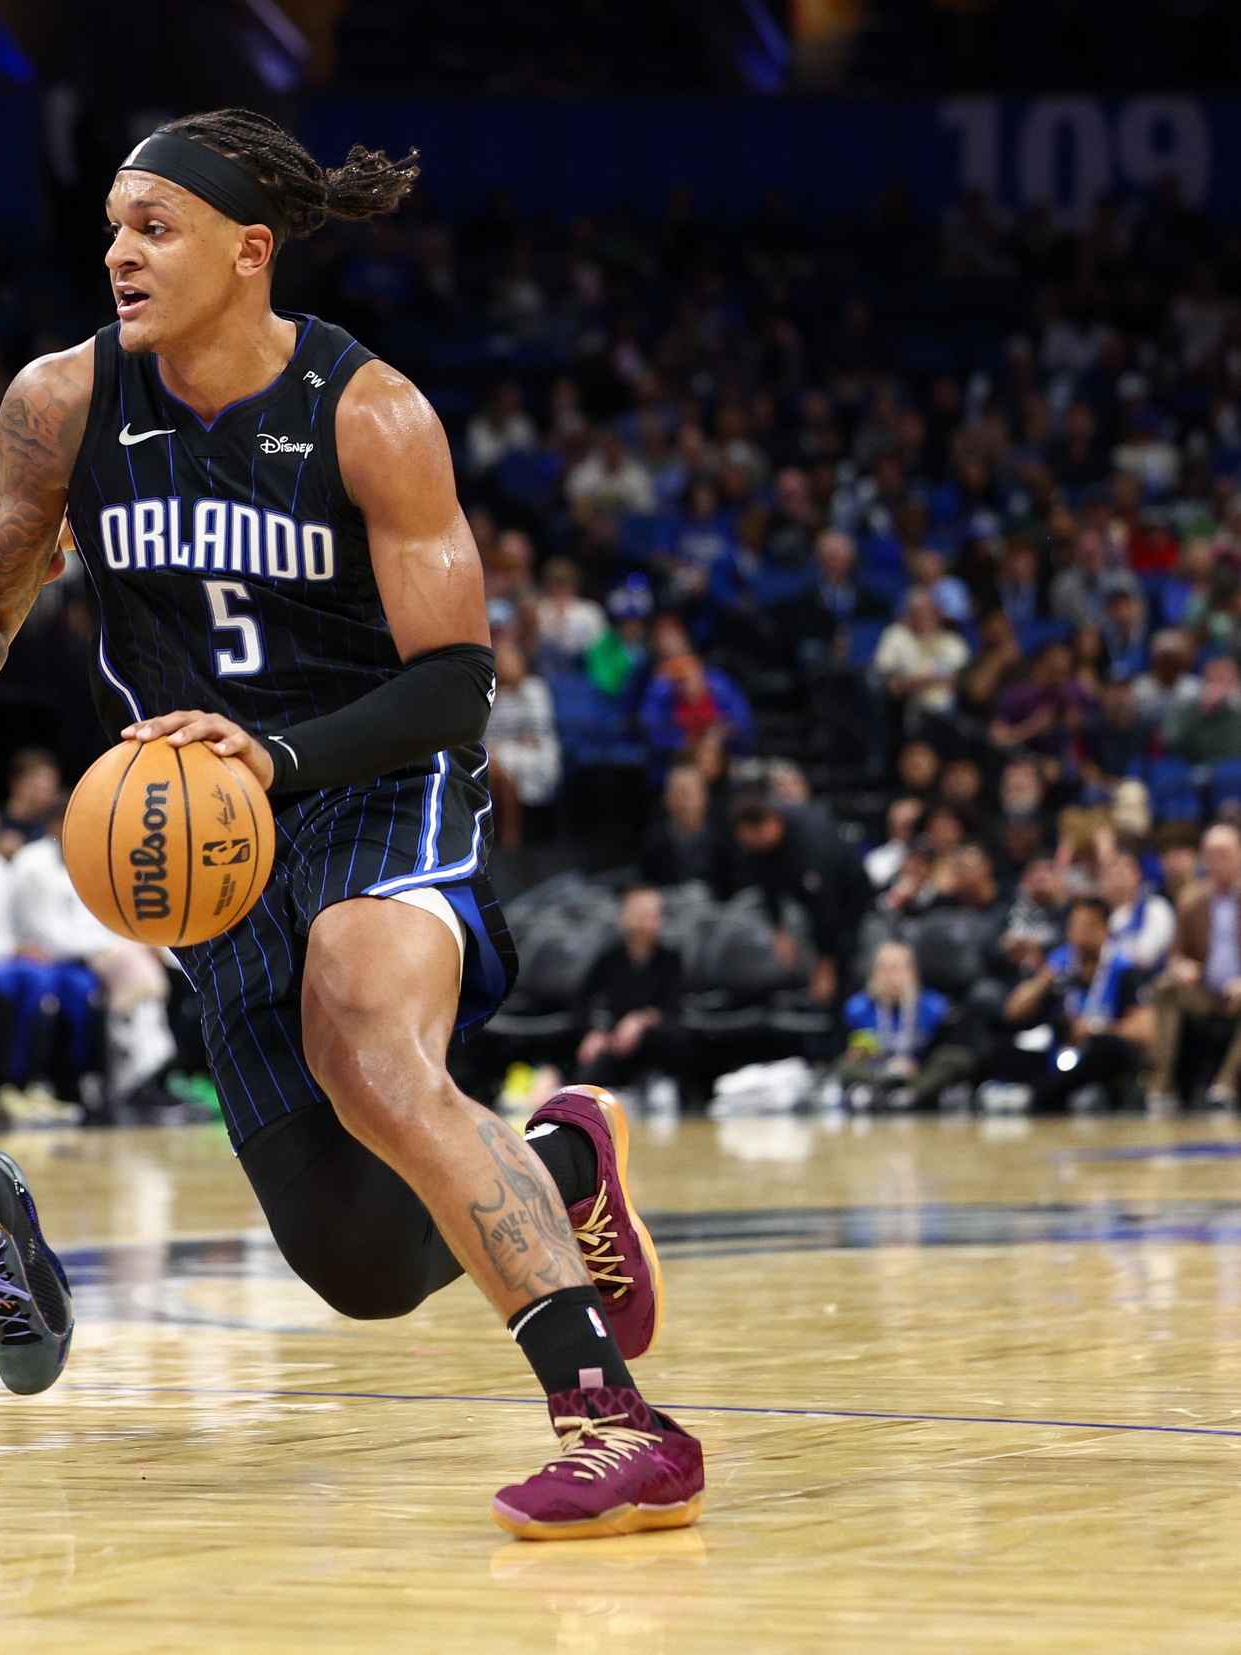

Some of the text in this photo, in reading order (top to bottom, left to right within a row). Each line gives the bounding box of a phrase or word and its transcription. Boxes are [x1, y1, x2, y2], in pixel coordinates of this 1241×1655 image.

[939, 92, 1211, 237] 109
[302, 370, 326, 389] PW
[256, 433, 314, 460] Disney
[99, 496, 337, 582] ORLANDO
[202, 579, 266, 679] 5
[129, 780, 172, 922] Wilson
[491, 1210, 528, 1242] DUKE
[509, 1228, 528, 1252] 5
